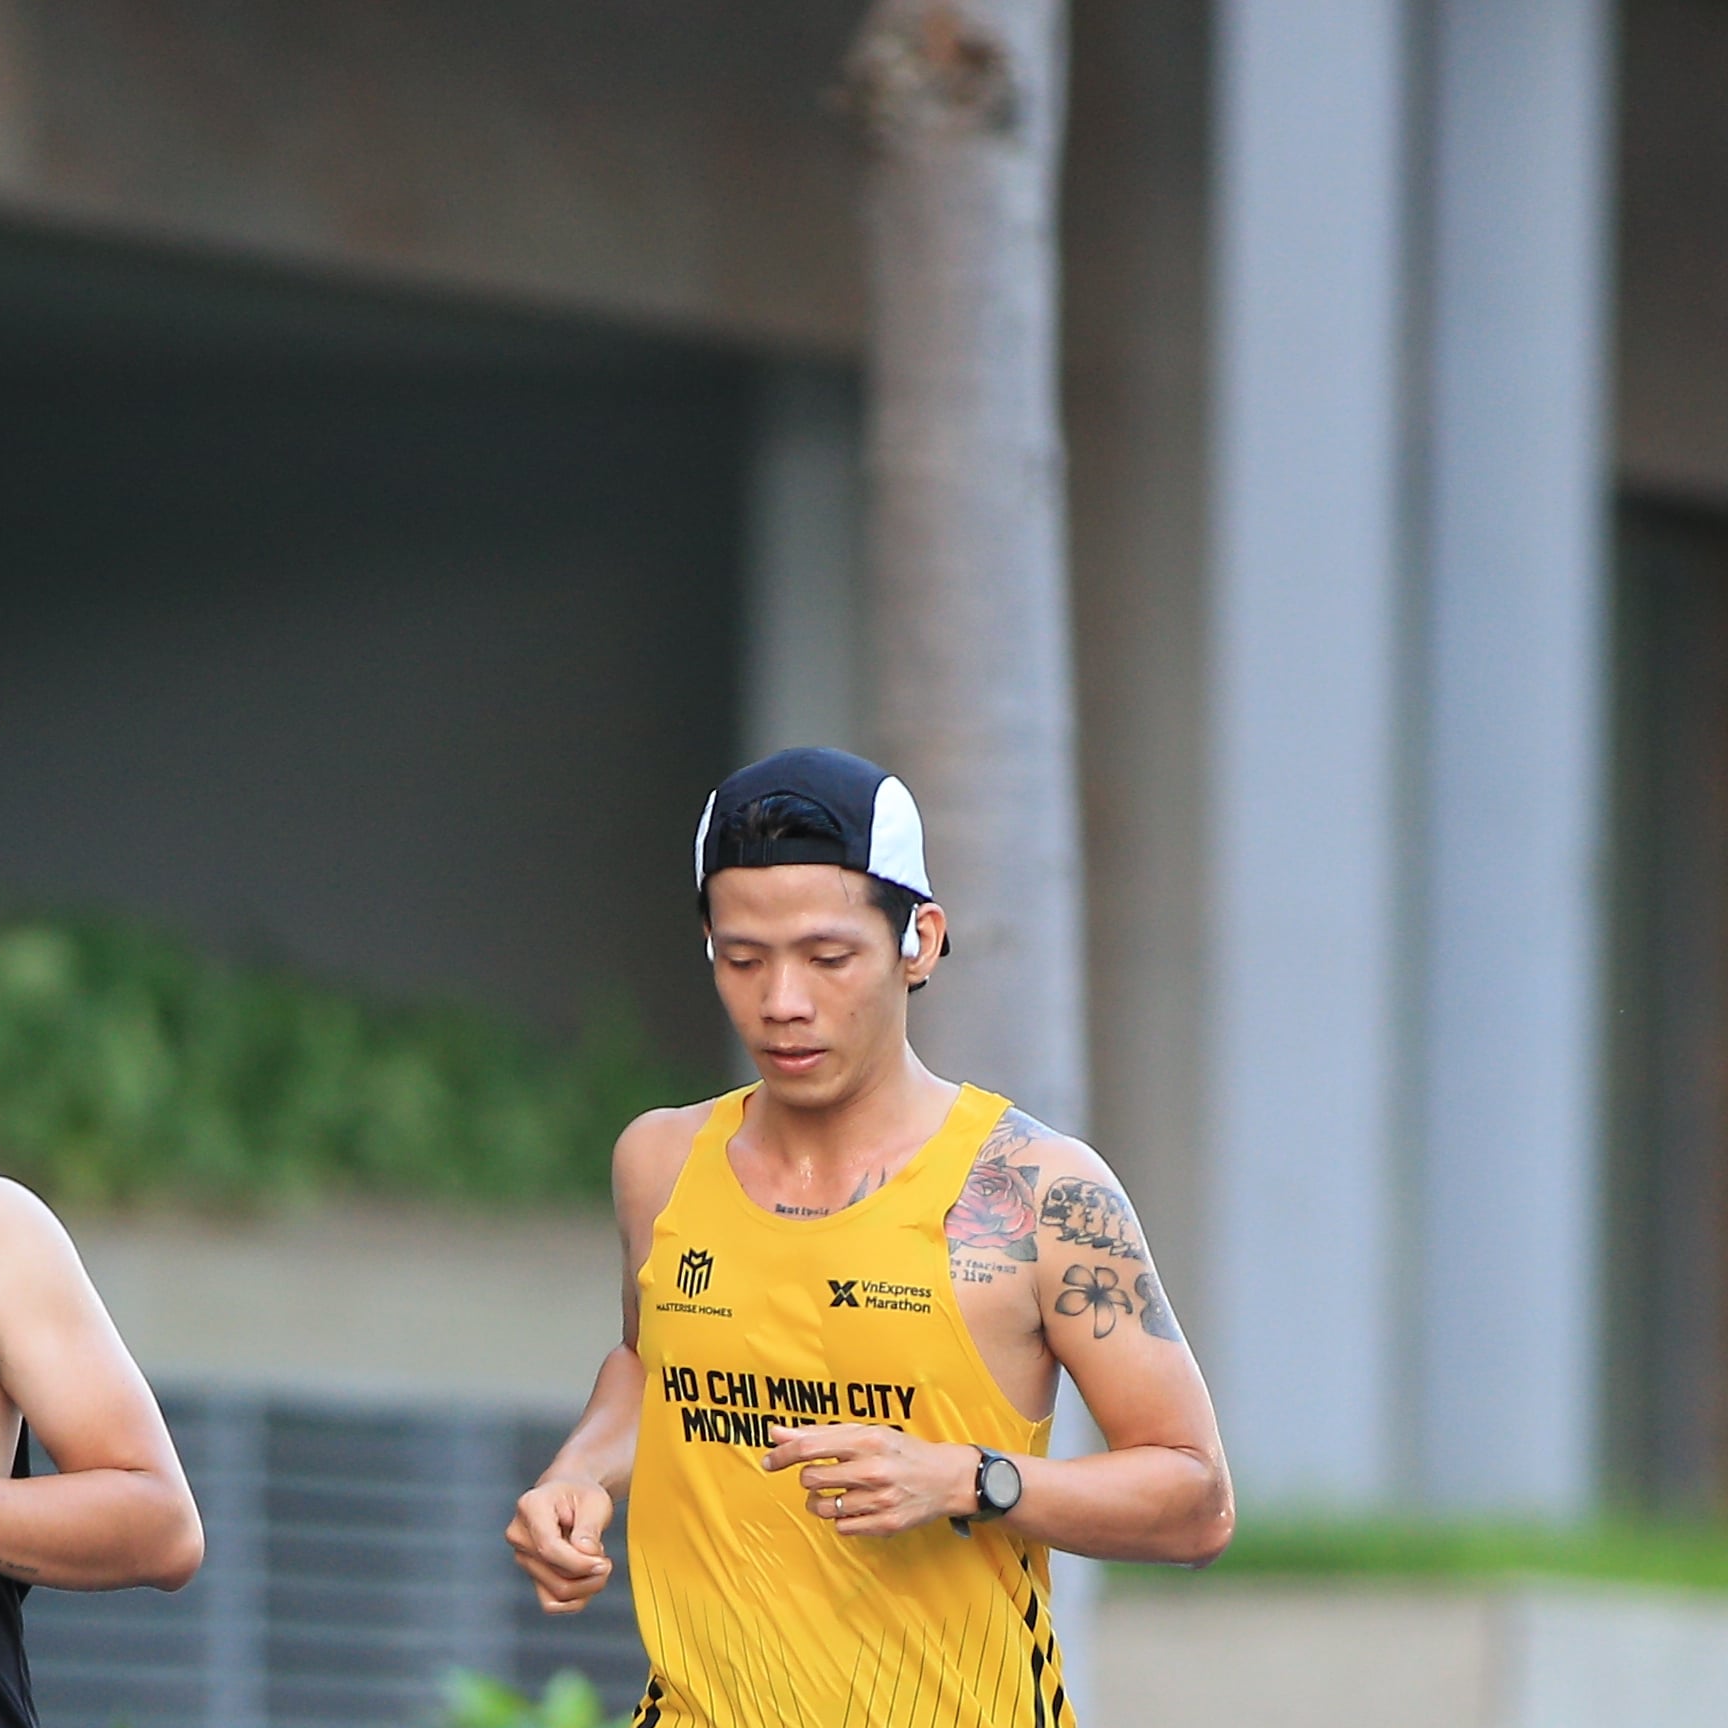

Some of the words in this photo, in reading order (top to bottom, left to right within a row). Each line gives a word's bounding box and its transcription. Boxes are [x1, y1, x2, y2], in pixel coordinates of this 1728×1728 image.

[861, 1280, 932, 1298] VnExpress
[656, 1303, 697, 1314] MASTERISE
[698, 1305, 733, 1318] HOMES
[865, 1296, 931, 1314] Marathon
[662, 1366, 699, 1402] HO
[706, 1370, 759, 1408] CHI
[765, 1376, 840, 1415] MINH
[847, 1382, 916, 1419] CITY
[681, 1407, 816, 1448] MIDNIG
